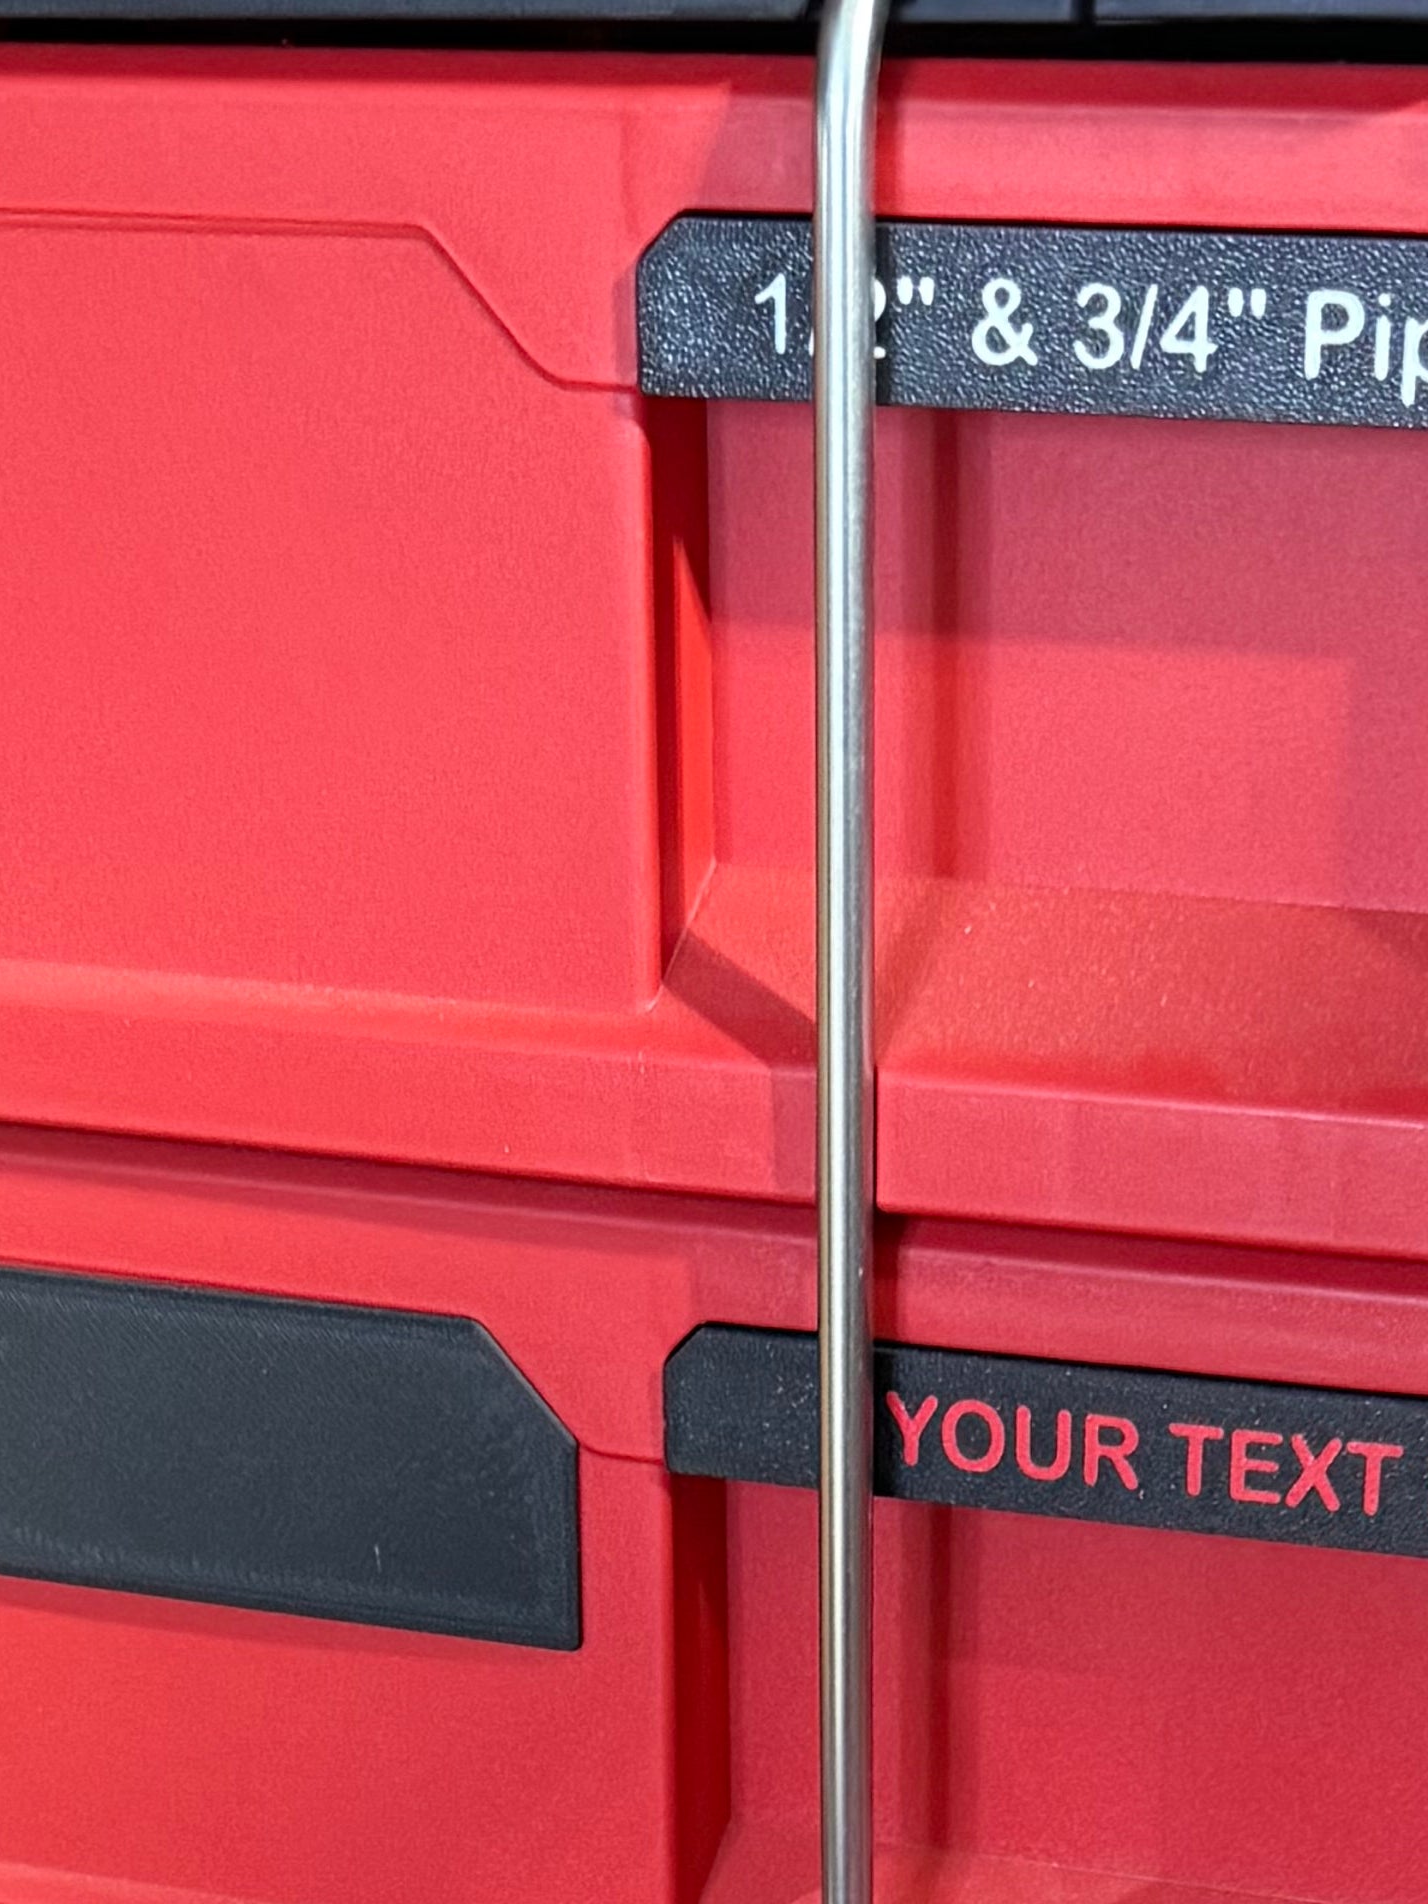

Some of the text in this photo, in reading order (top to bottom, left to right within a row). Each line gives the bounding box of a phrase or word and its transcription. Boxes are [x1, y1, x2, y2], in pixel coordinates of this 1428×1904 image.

[754, 272, 936, 358] 1"
[970, 276, 1041, 367] &
[1072, 281, 1268, 374] 3/4"
[886, 1392, 1139, 1491] YOUR
[1168, 1423, 1404, 1516] TEXT
